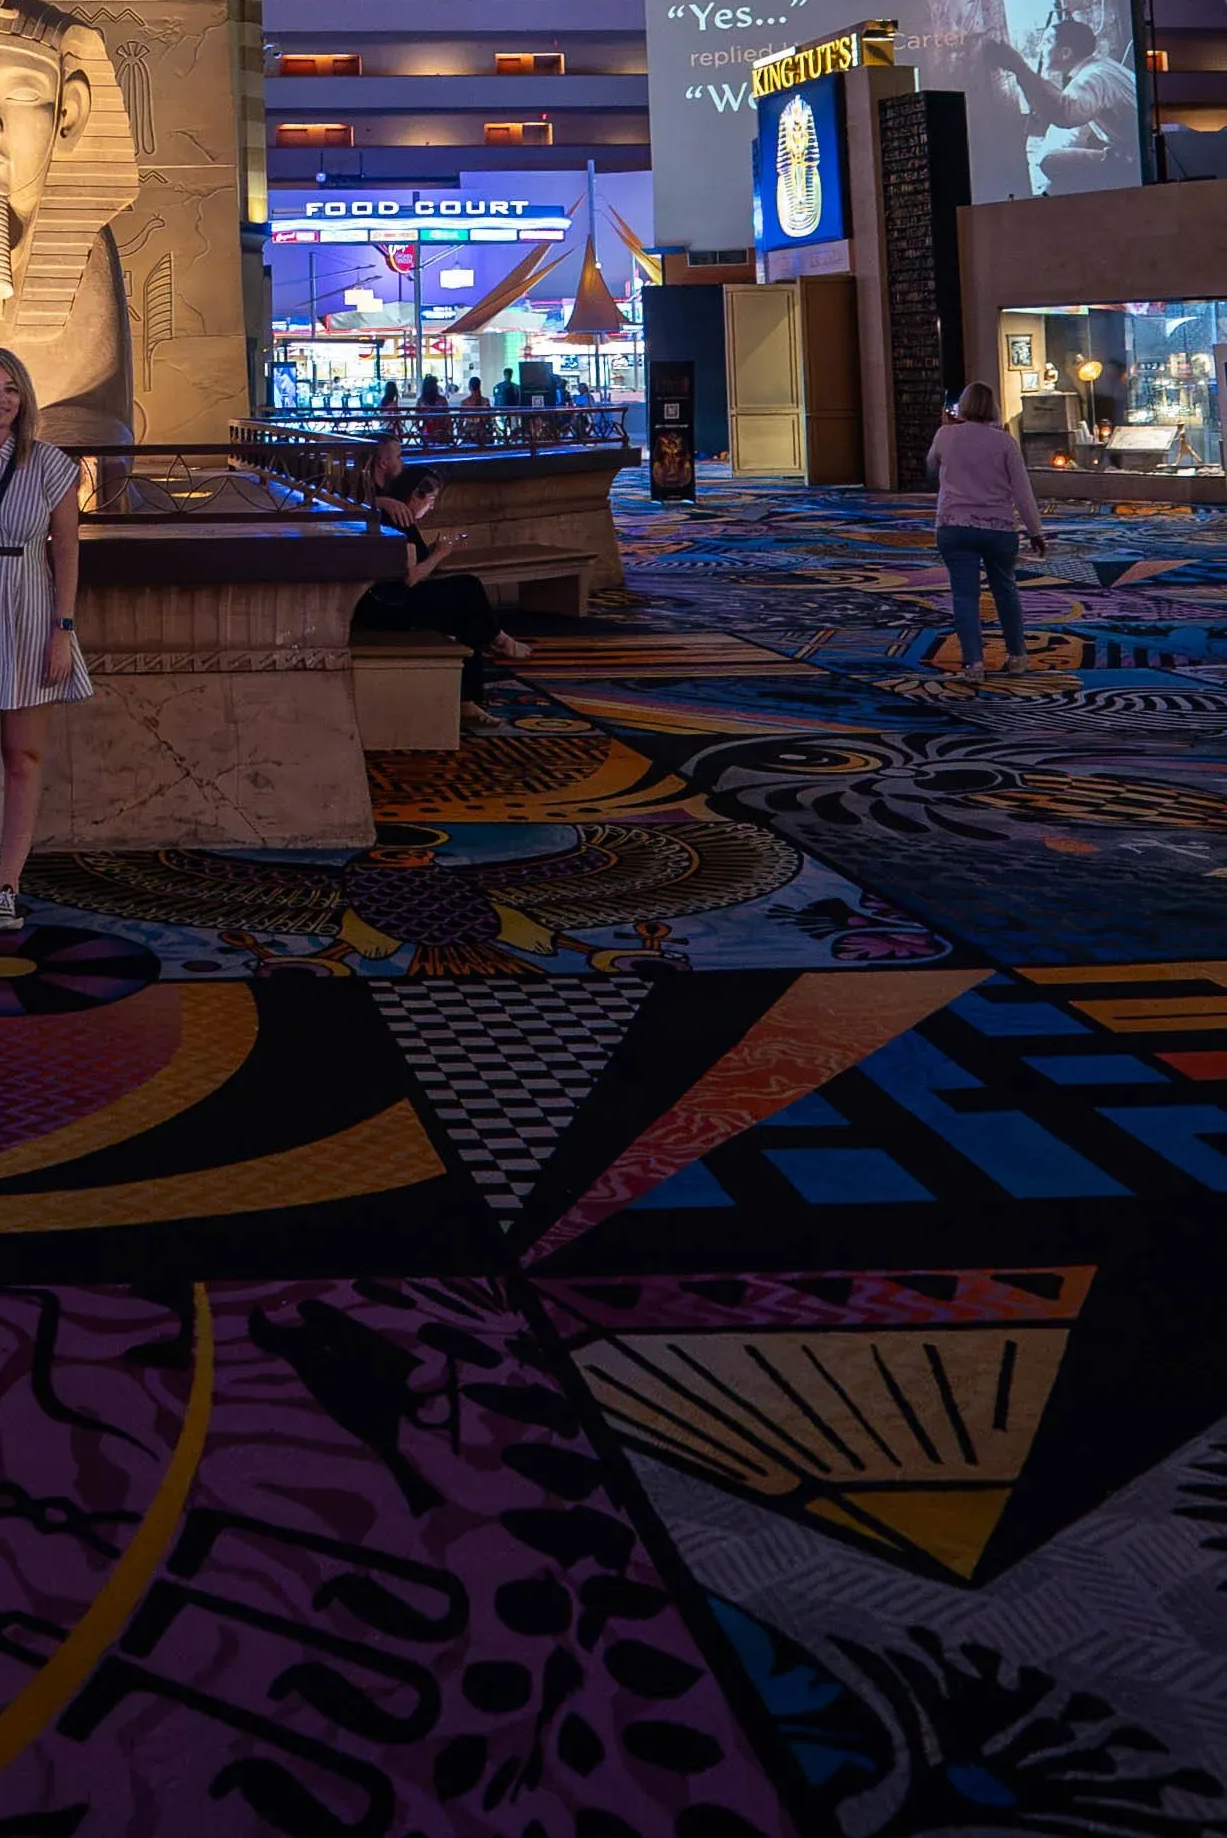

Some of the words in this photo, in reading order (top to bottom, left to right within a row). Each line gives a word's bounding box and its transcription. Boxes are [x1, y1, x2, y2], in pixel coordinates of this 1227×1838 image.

[689, 44, 773, 68] replied
[752, 57, 795, 98] KING
[795, 36, 852, 82] TUT'S
[306, 201, 400, 217] FOOD
[415, 200, 530, 216] COURT
